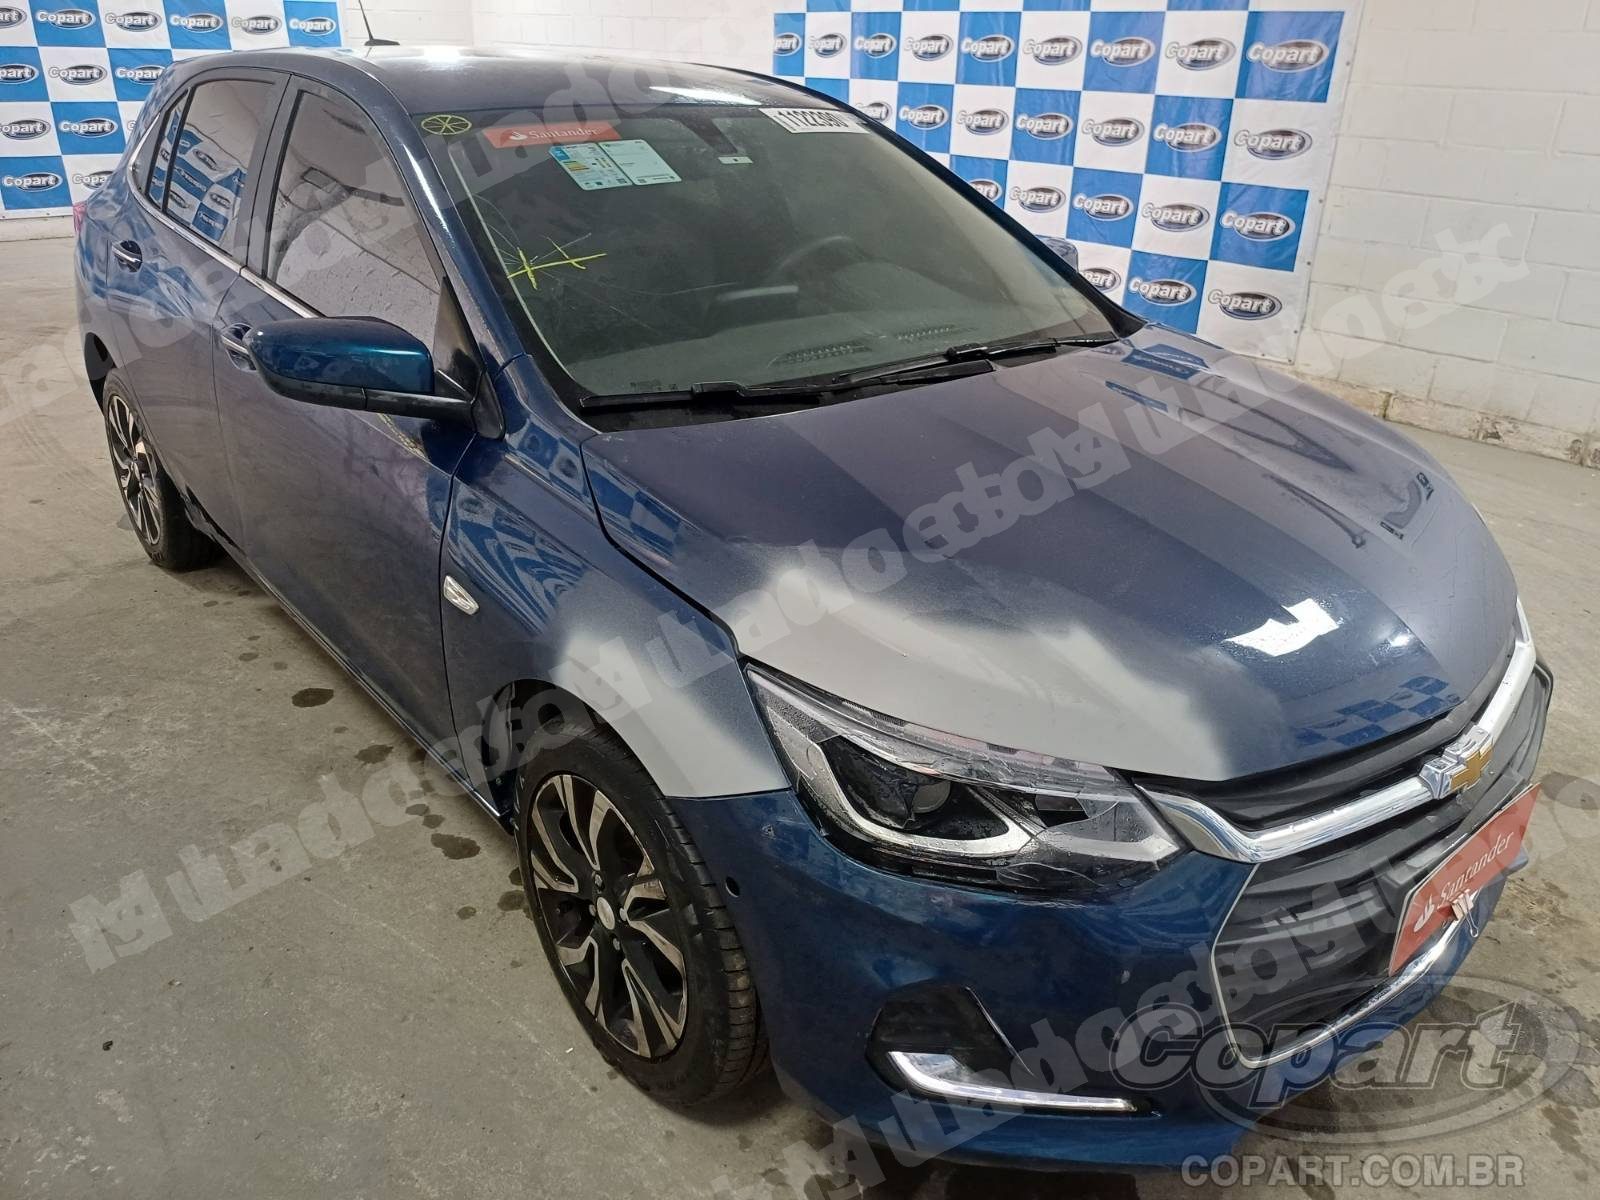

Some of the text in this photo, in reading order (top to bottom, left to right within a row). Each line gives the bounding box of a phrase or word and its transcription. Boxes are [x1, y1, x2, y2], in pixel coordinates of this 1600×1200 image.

[36, 10, 90, 25] Copart
[105, 12, 154, 27] Copart
[170, 14, 217, 29] Copart
[232, 16, 276, 30] Copart
[289, 18, 331, 32] Copart
[775, 36, 798, 53] part
[904, 37, 946, 54] Copart
[961, 37, 1009, 58] Copart
[1023, 39, 1076, 58] Copart
[1091, 39, 1149, 61] Copart
[1165, 41, 1225, 61] Copart
[1246, 42, 1321, 65] Copart
[0, 67, 32, 81] part
[48, 66, 100, 82] Copart
[899, 105, 943, 126] Copart
[957, 110, 1002, 129] Copart
[1017, 113, 1068, 133] Copart
[0, 121, 43, 136] opart
[59, 120, 112, 135] Copart
[528, 126, 600, 140] Santander
[1082, 118, 1136, 141] Copart
[1153, 123, 1215, 147] Copart
[1234, 128, 1301, 152] Copart
[3, 174, 57, 189] Copart
[72, 173, 106, 187] Copa
[1010, 186, 1060, 206] Copart
[1073, 193, 1128, 215] Copart
[1141, 202, 1201, 225] Copart
[1220, 211, 1285, 236] Copart
[1128, 277, 1190, 301] Copart
[1208, 288, 1272, 313] Copart
[1437, 832, 1514, 909] Santander
